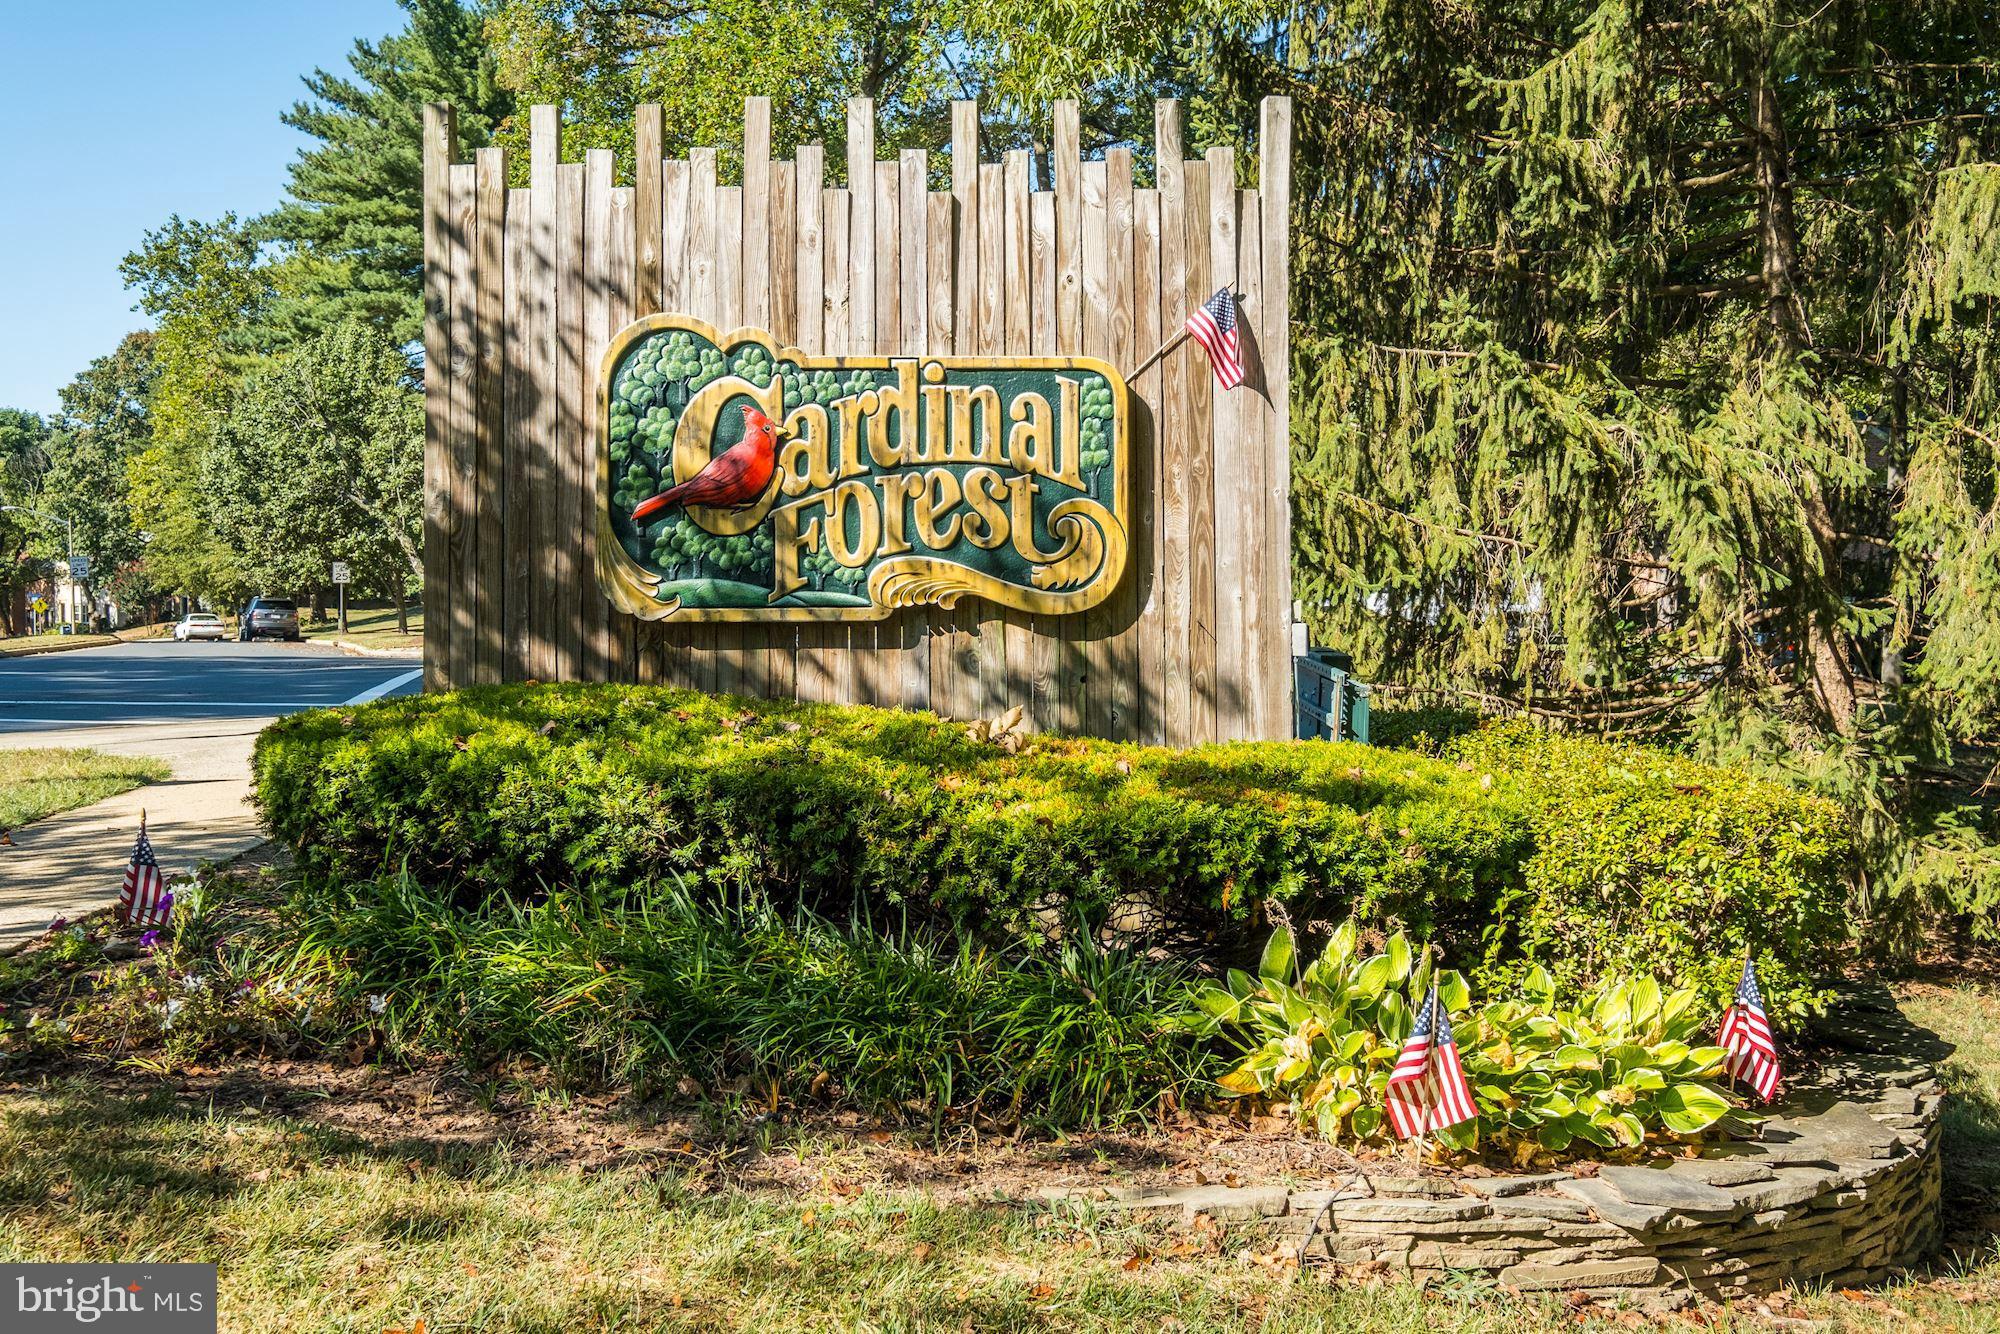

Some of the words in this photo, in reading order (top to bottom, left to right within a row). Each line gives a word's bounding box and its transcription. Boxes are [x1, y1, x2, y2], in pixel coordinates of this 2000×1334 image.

[672, 357, 1087, 536] Cardinal
[768, 466, 1082, 602] Forest
[72, 567, 87, 576] 25
[335, 572, 349, 581] 25
